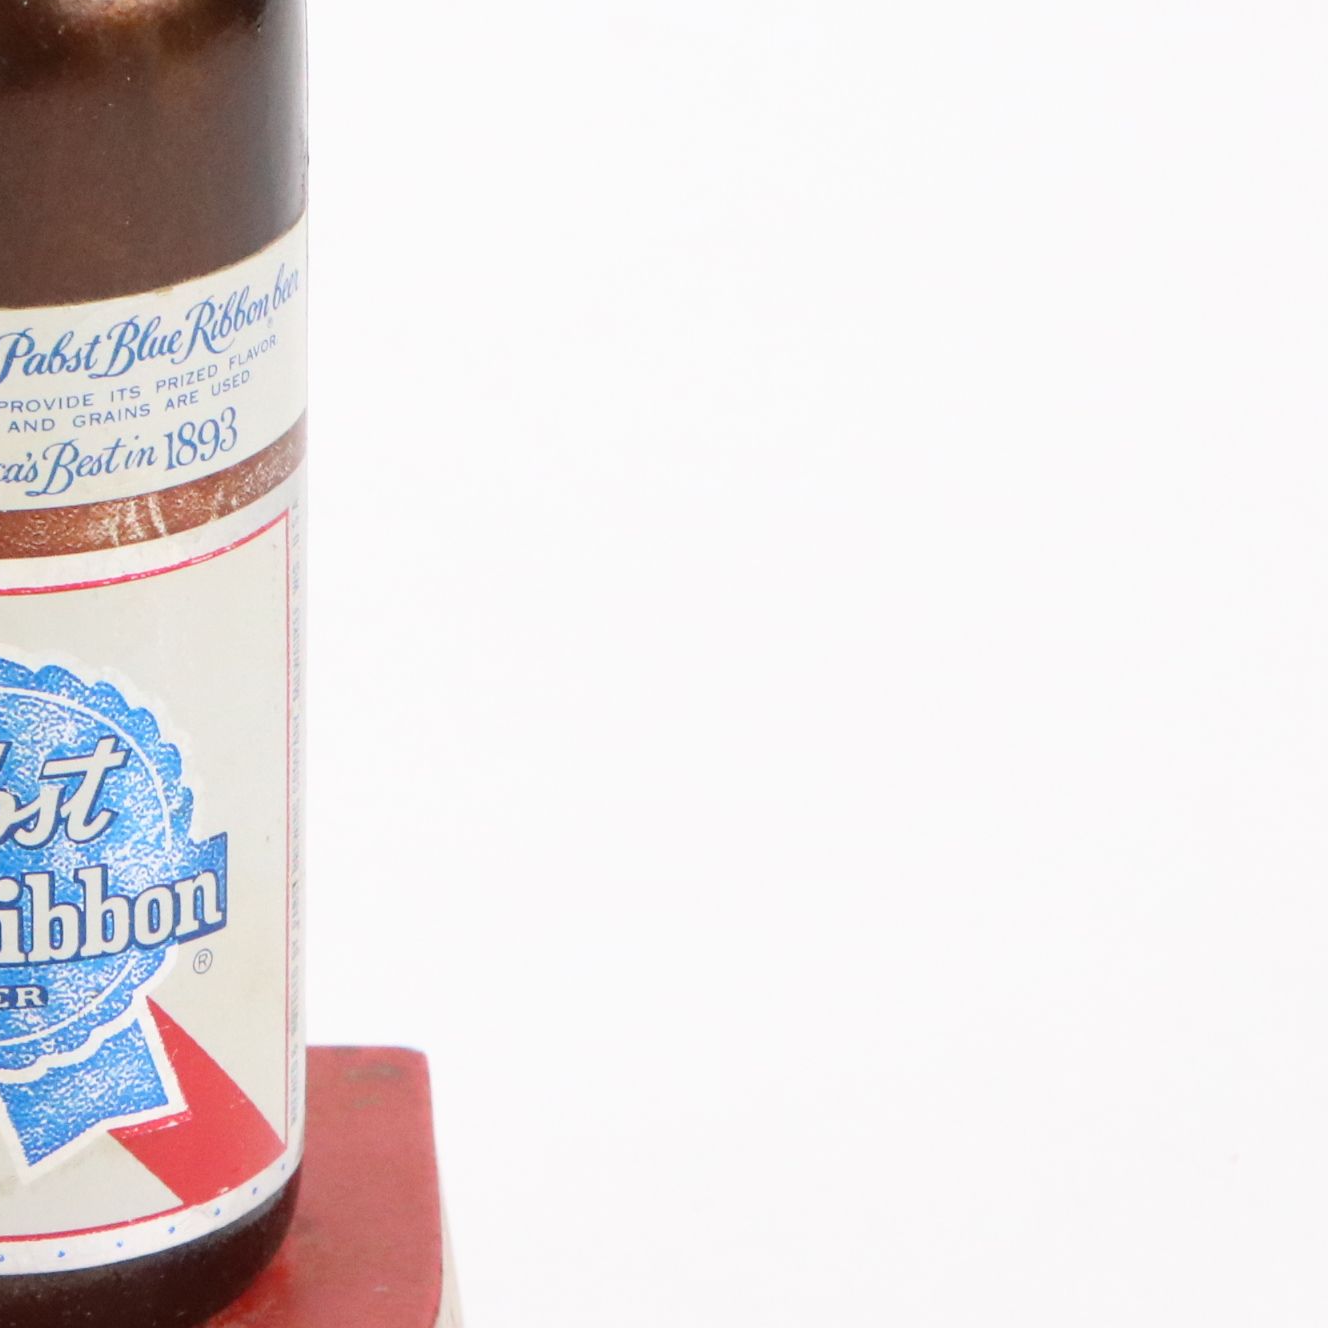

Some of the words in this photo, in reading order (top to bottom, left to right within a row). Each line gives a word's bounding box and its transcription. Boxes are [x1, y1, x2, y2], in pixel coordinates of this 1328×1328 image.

[88, 314, 183, 379] Blue
[171, 286, 269, 364] Ribbon
[273, 263, 299, 311] beer
[7, 420, 55, 433] AND
[73, 404, 150, 428] GRAINS
[165, 390, 198, 411] ARE
[211, 370, 251, 396] USED
[110, 387, 141, 403] ITS
[156, 364, 218, 392] PRIZED
[229, 334, 278, 369] FLAVOR
[25, 437, 126, 497] Best
[125, 436, 157, 468] in
[164, 406, 238, 471] 1893
